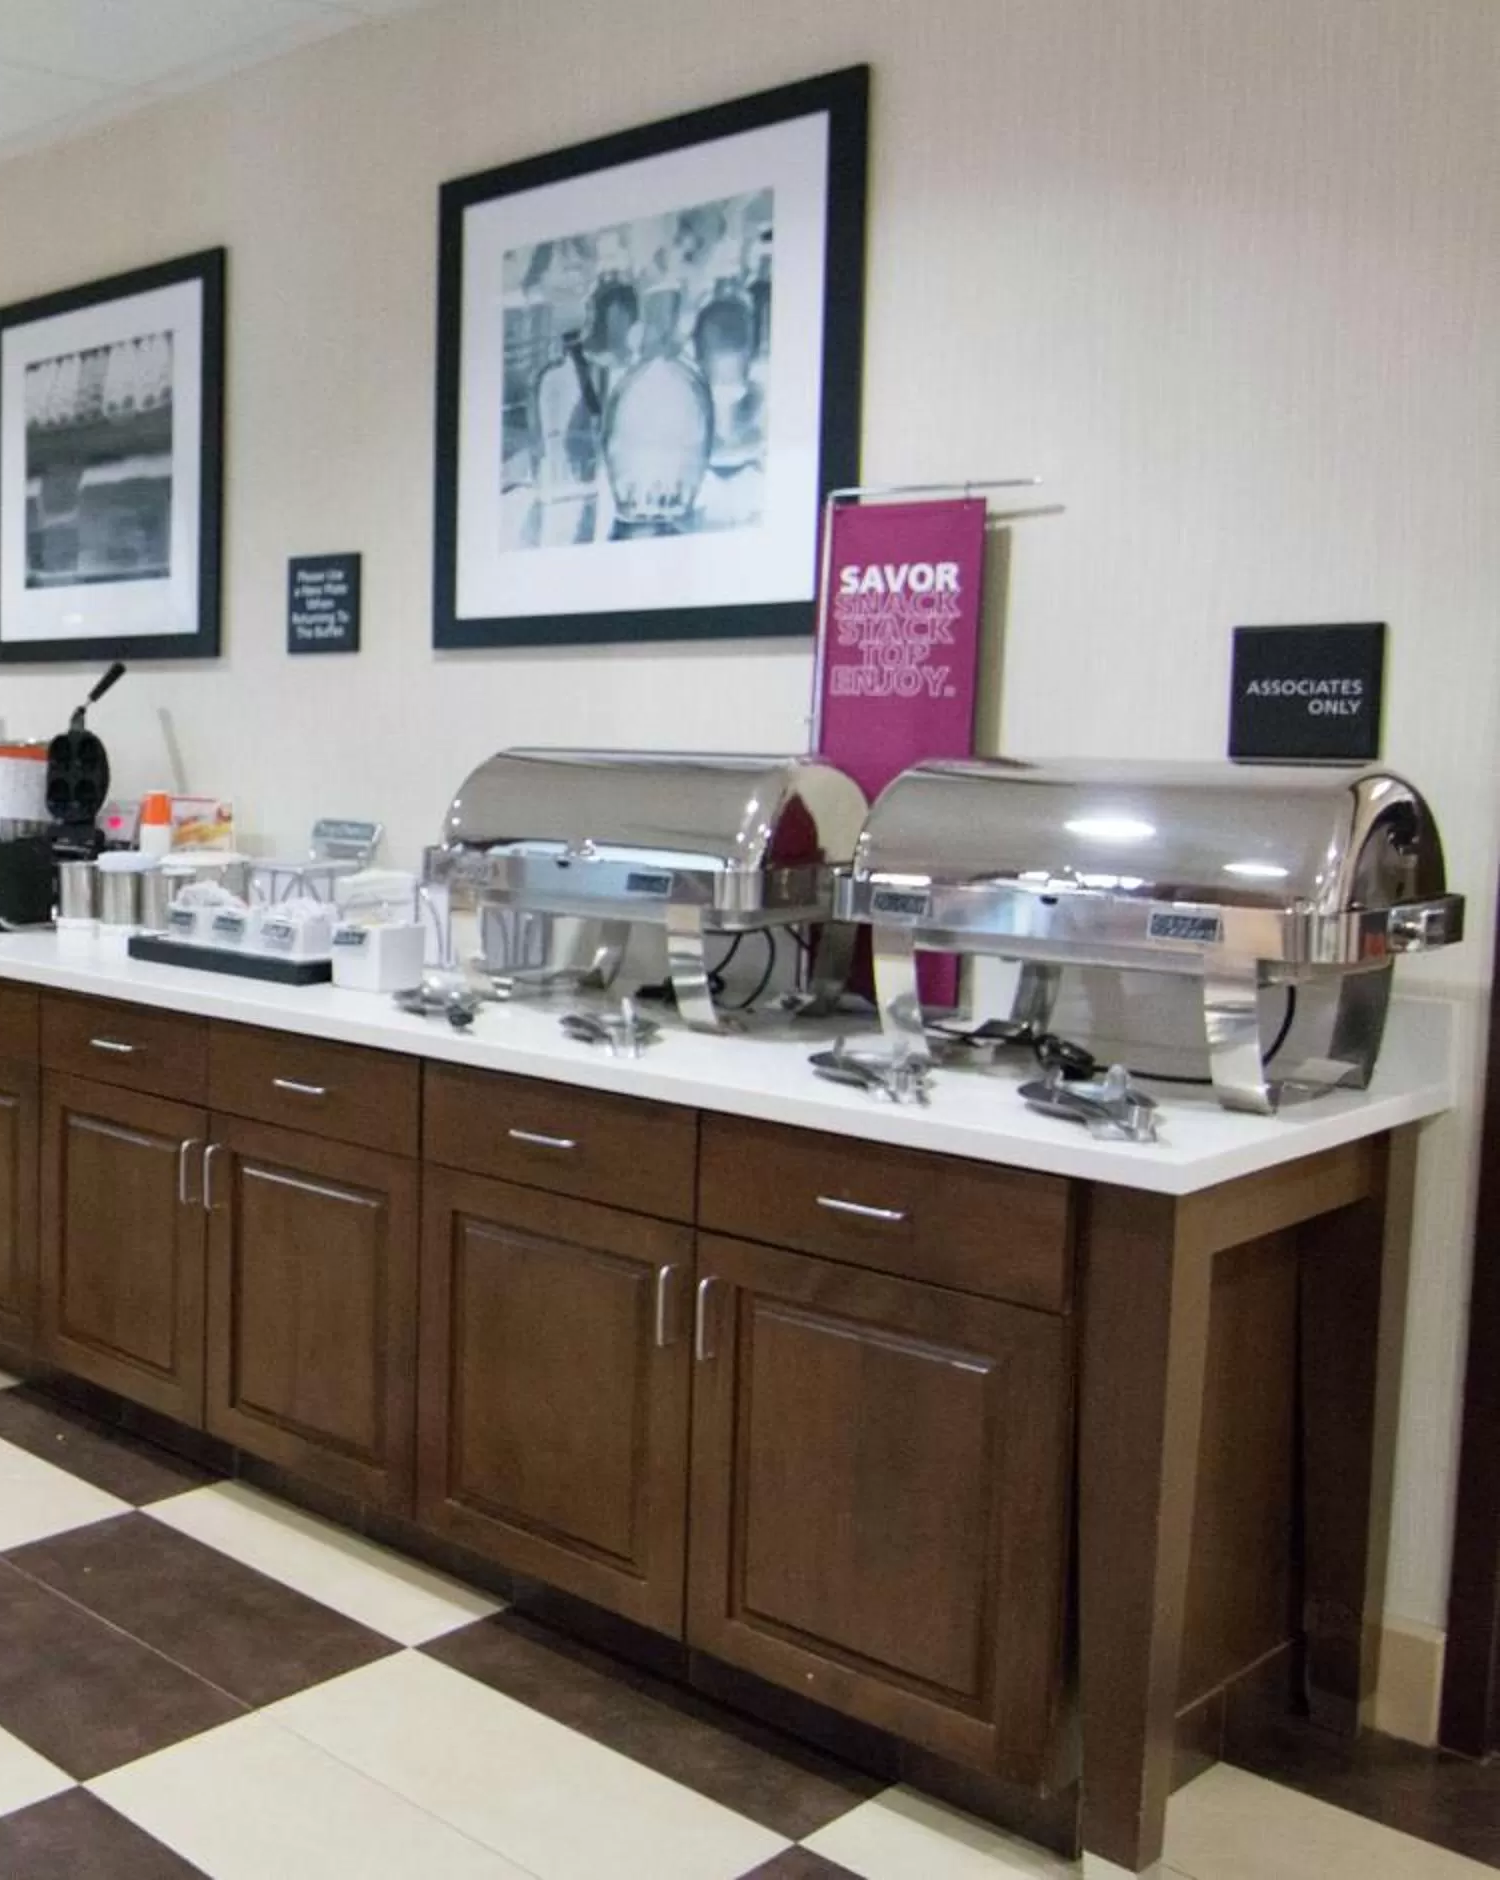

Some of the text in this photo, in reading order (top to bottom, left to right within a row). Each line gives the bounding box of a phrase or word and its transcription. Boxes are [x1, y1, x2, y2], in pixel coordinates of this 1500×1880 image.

[839, 562, 960, 593] SAVOR
[836, 615, 955, 646] STACK
[858, 641, 931, 668] TOP
[829, 664, 957, 697] ENJOY.
[1246, 678, 1363, 697] ASSOCIATES
[1307, 698, 1362, 715] ONLY
